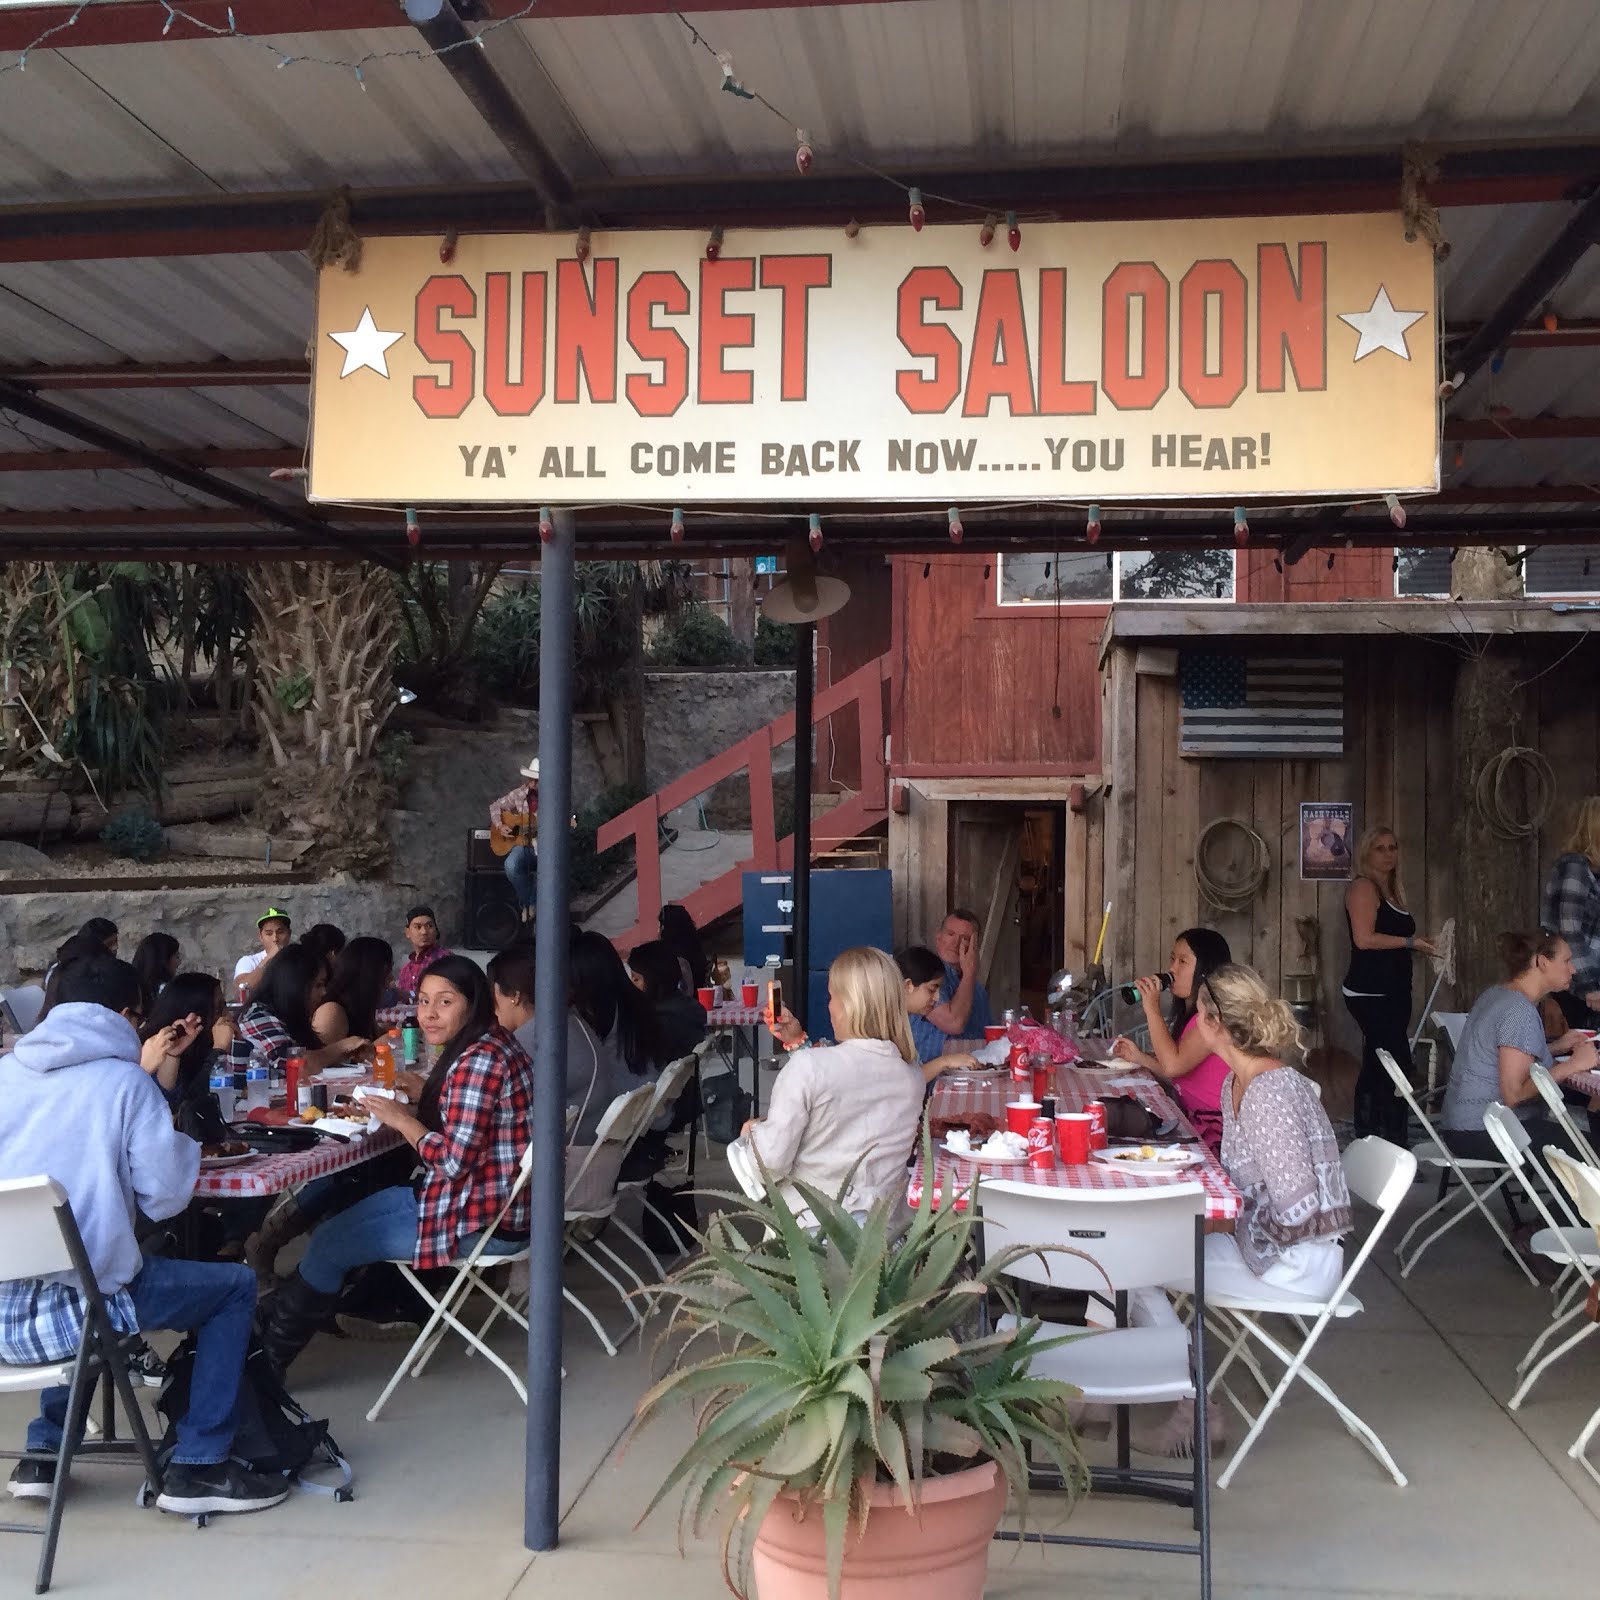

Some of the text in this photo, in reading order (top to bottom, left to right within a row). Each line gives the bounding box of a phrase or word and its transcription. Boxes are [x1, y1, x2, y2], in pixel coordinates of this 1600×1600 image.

[413, 241, 1328, 419] SUNSET SALOON
[459, 444, 517, 478] YA'
[539, 446, 606, 478] ALL
[630, 441, 736, 476] COME
[761, 440, 861, 476] BACK
[1151, 433, 1271, 471] HEAR!
[1303, 810, 1350, 818] NASHVILLE
